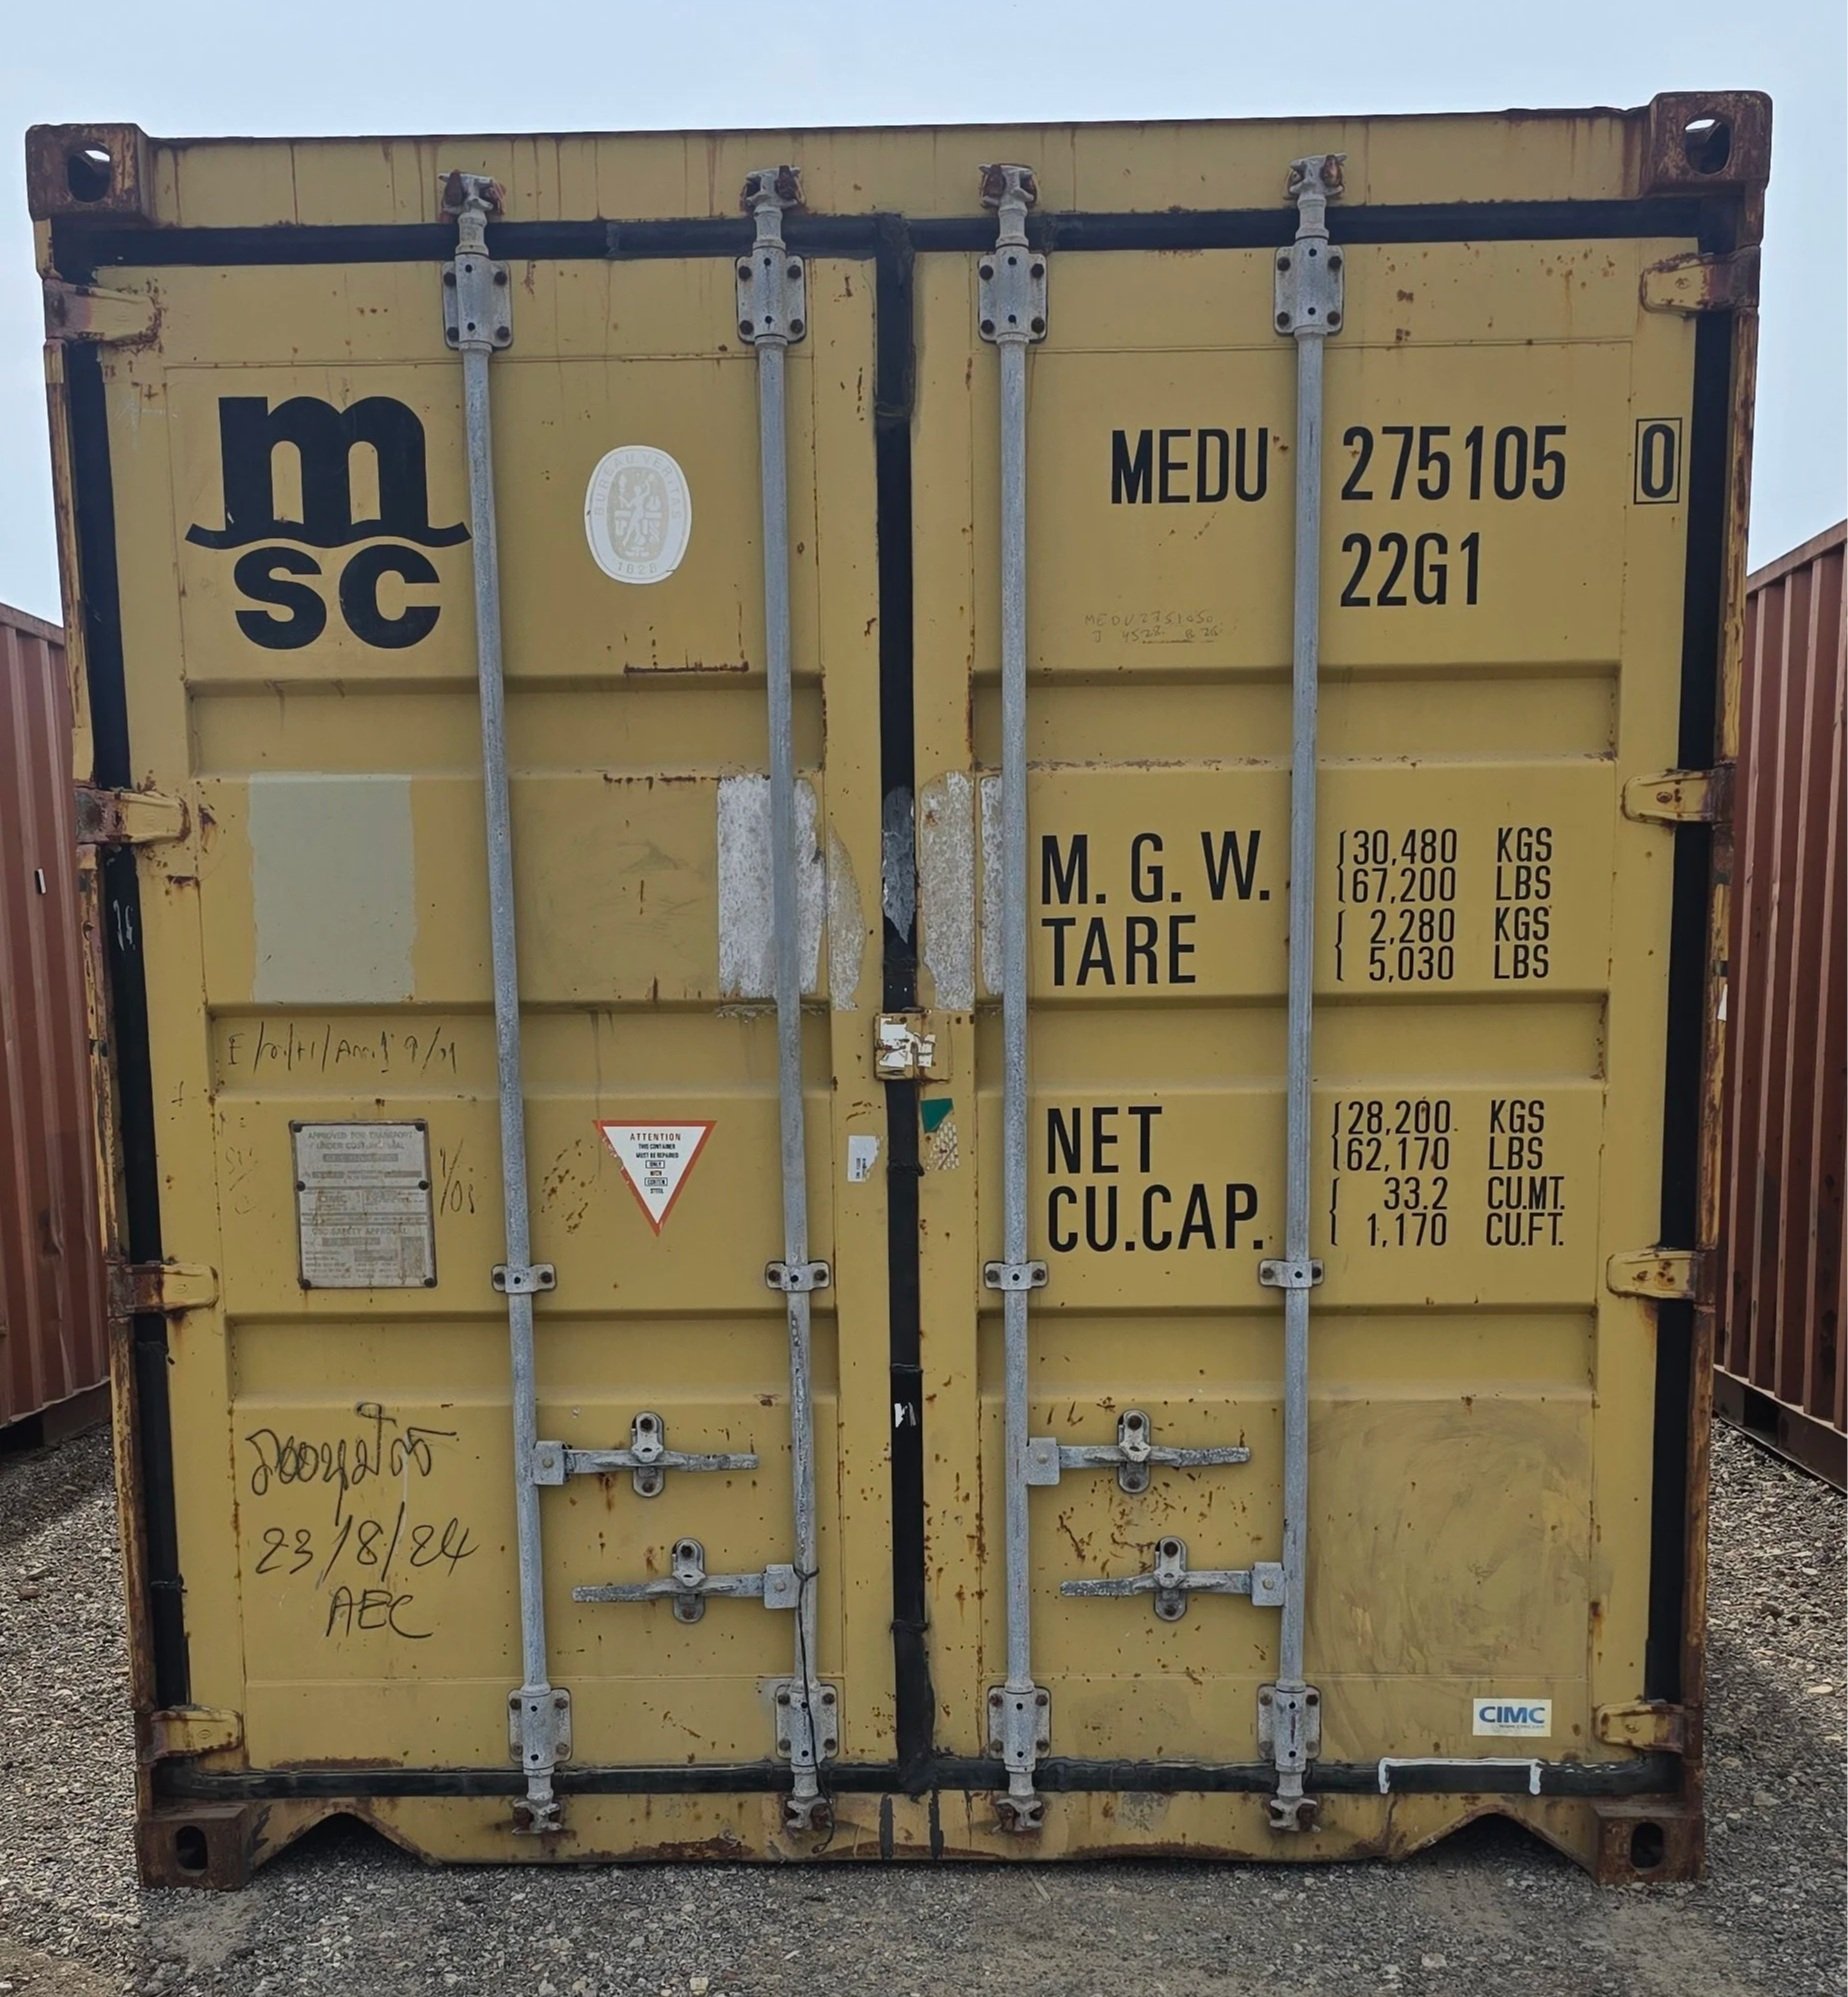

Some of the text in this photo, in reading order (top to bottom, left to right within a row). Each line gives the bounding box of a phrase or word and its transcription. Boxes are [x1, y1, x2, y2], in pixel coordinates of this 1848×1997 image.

[1112, 424, 1676, 504] MEDU 275105 0
[1340, 531, 1480, 607] 22G1
[1353, 827, 1553, 867] 30,480 KGS
[1041, 830, 1271, 905] M. G. W.
[1352, 864, 1552, 905] 67,200 LBS
[1369, 906, 1550, 946] 2,280 KGS
[1041, 914, 1196, 987] TARE
[1368, 943, 1549, 983] 5,030 LBS
[629, 1133, 682, 1141] ATTENTION
[1347, 1099, 1545, 1136] 28,200 KGS
[1047, 1106, 1163, 1175] NET
[1346, 1135, 1544, 1172] 62,170 LBS
[1383, 1175, 1566, 1211] 33.2 CU.MT.
[1048, 1183, 1264, 1253] CU.CAP.
[1366, 1211, 1565, 1248] 1,170 CU.FT.
[255, 1501, 480, 1582] 23/8/24
[325, 1585, 434, 1639] AEC
[1479, 1706, 1546, 1724] CIMC
